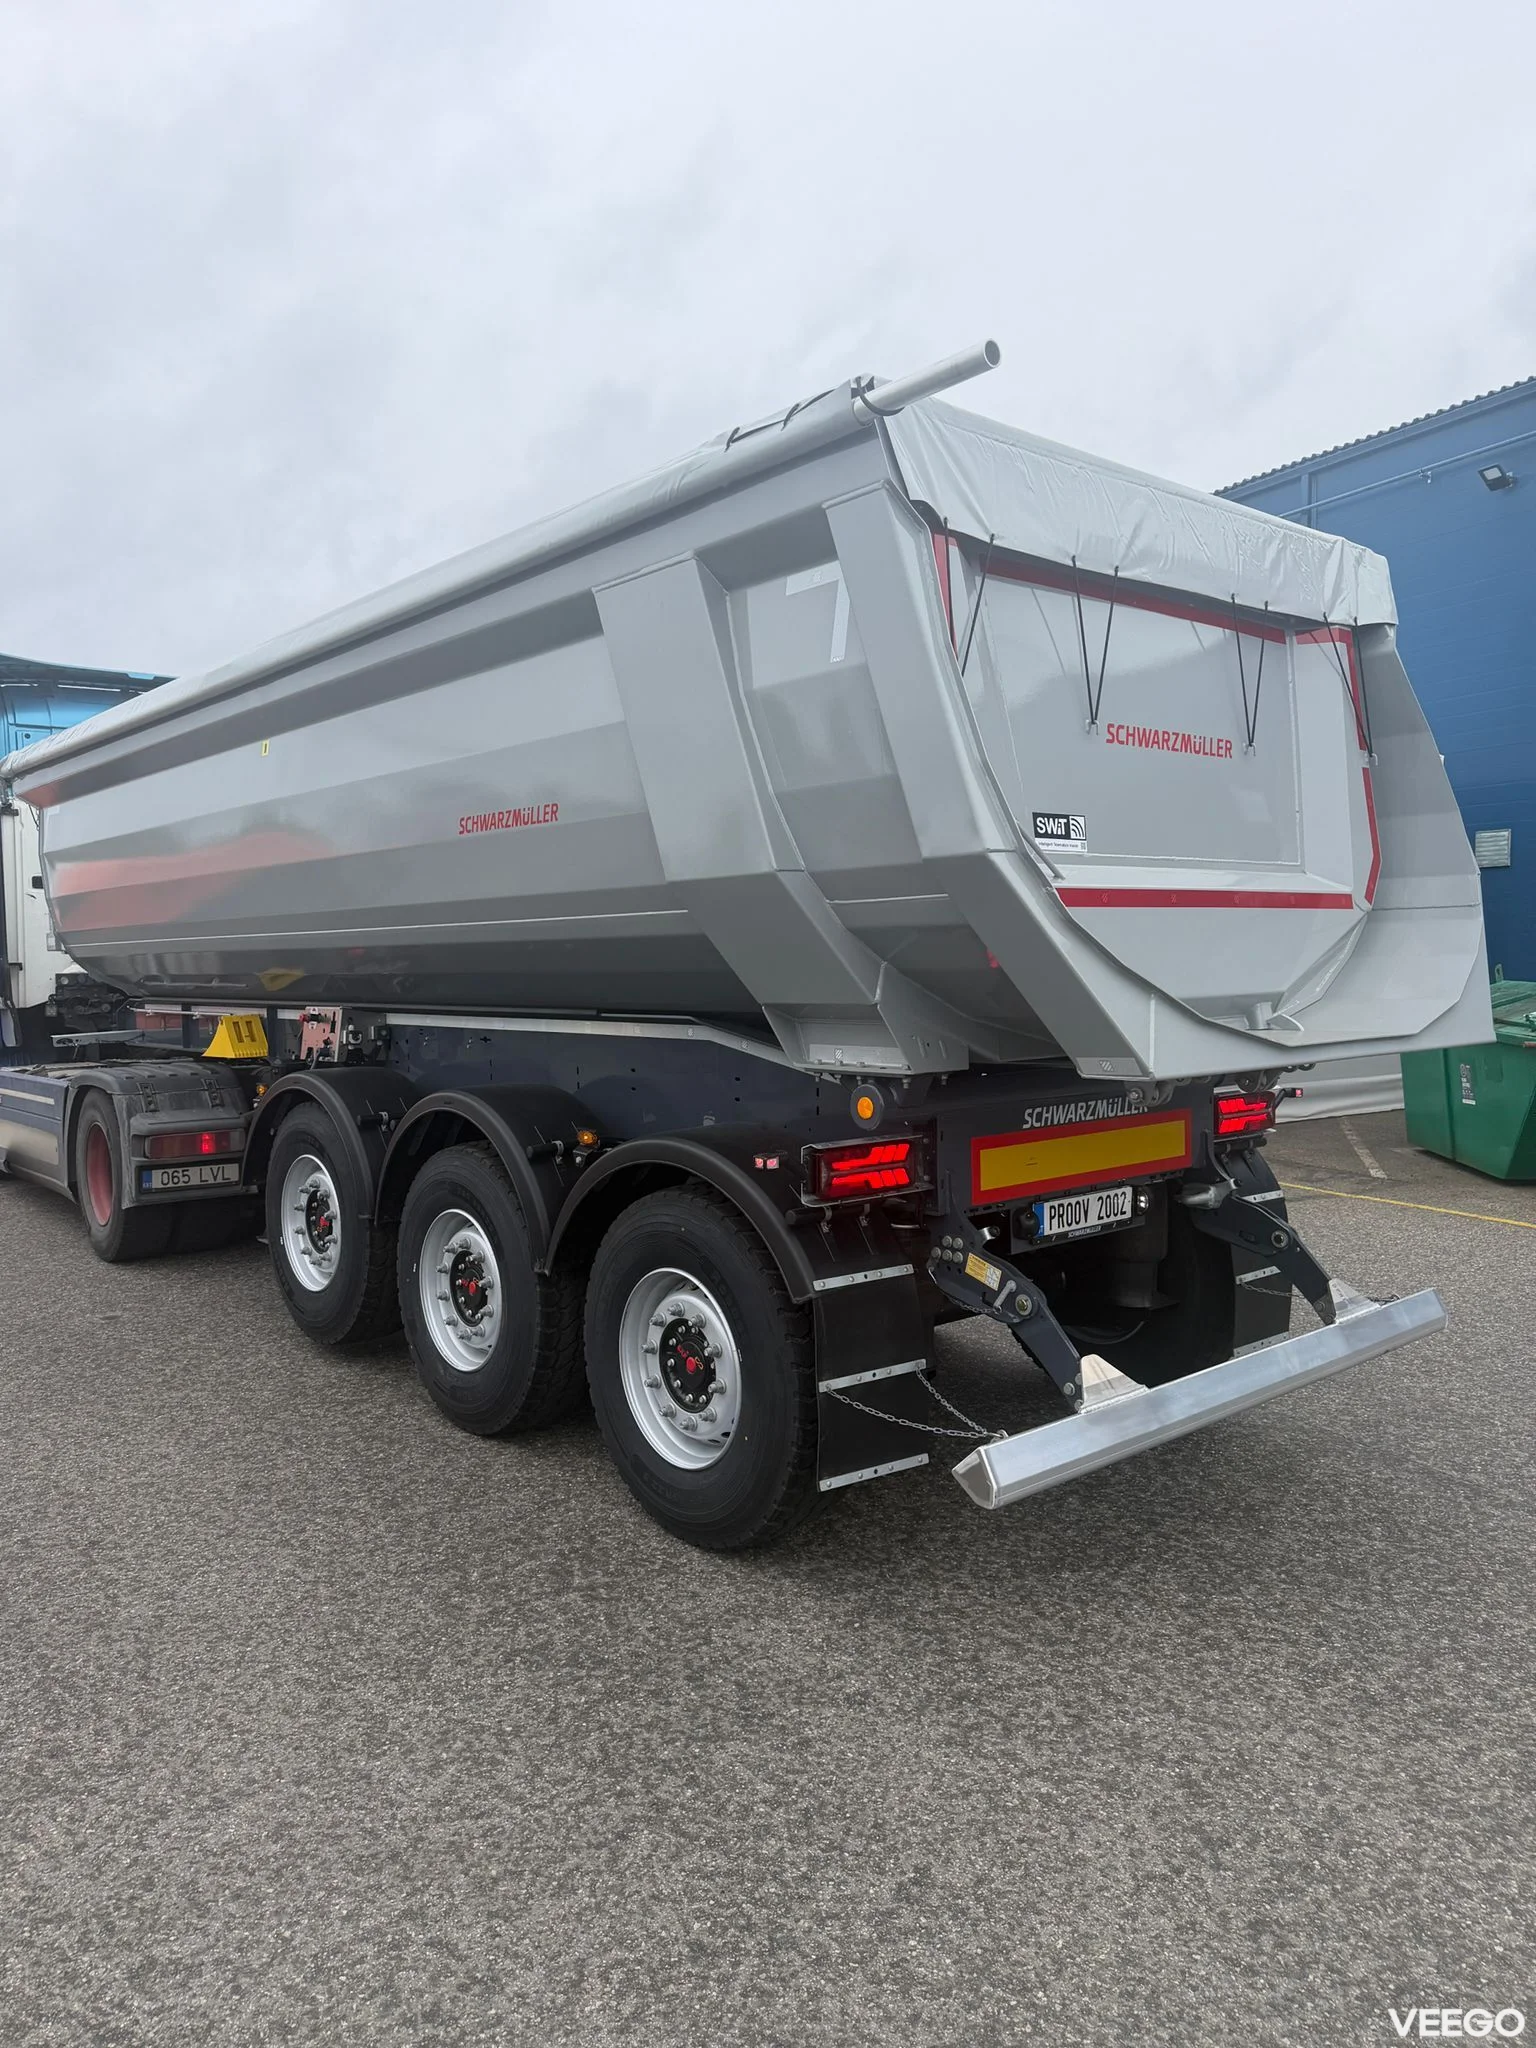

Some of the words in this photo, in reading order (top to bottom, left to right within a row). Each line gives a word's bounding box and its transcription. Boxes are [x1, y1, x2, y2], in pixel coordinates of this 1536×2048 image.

[1105, 723, 1233, 759] SCHWARZMÜLLER
[458, 803, 559, 835] SCHWARZMÜLLER
[160, 1168, 191, 1186] 065
[199, 1165, 231, 1183] LVL
[1048, 1197, 1090, 1231] PROOV
[1096, 1191, 1127, 1221] 2002
